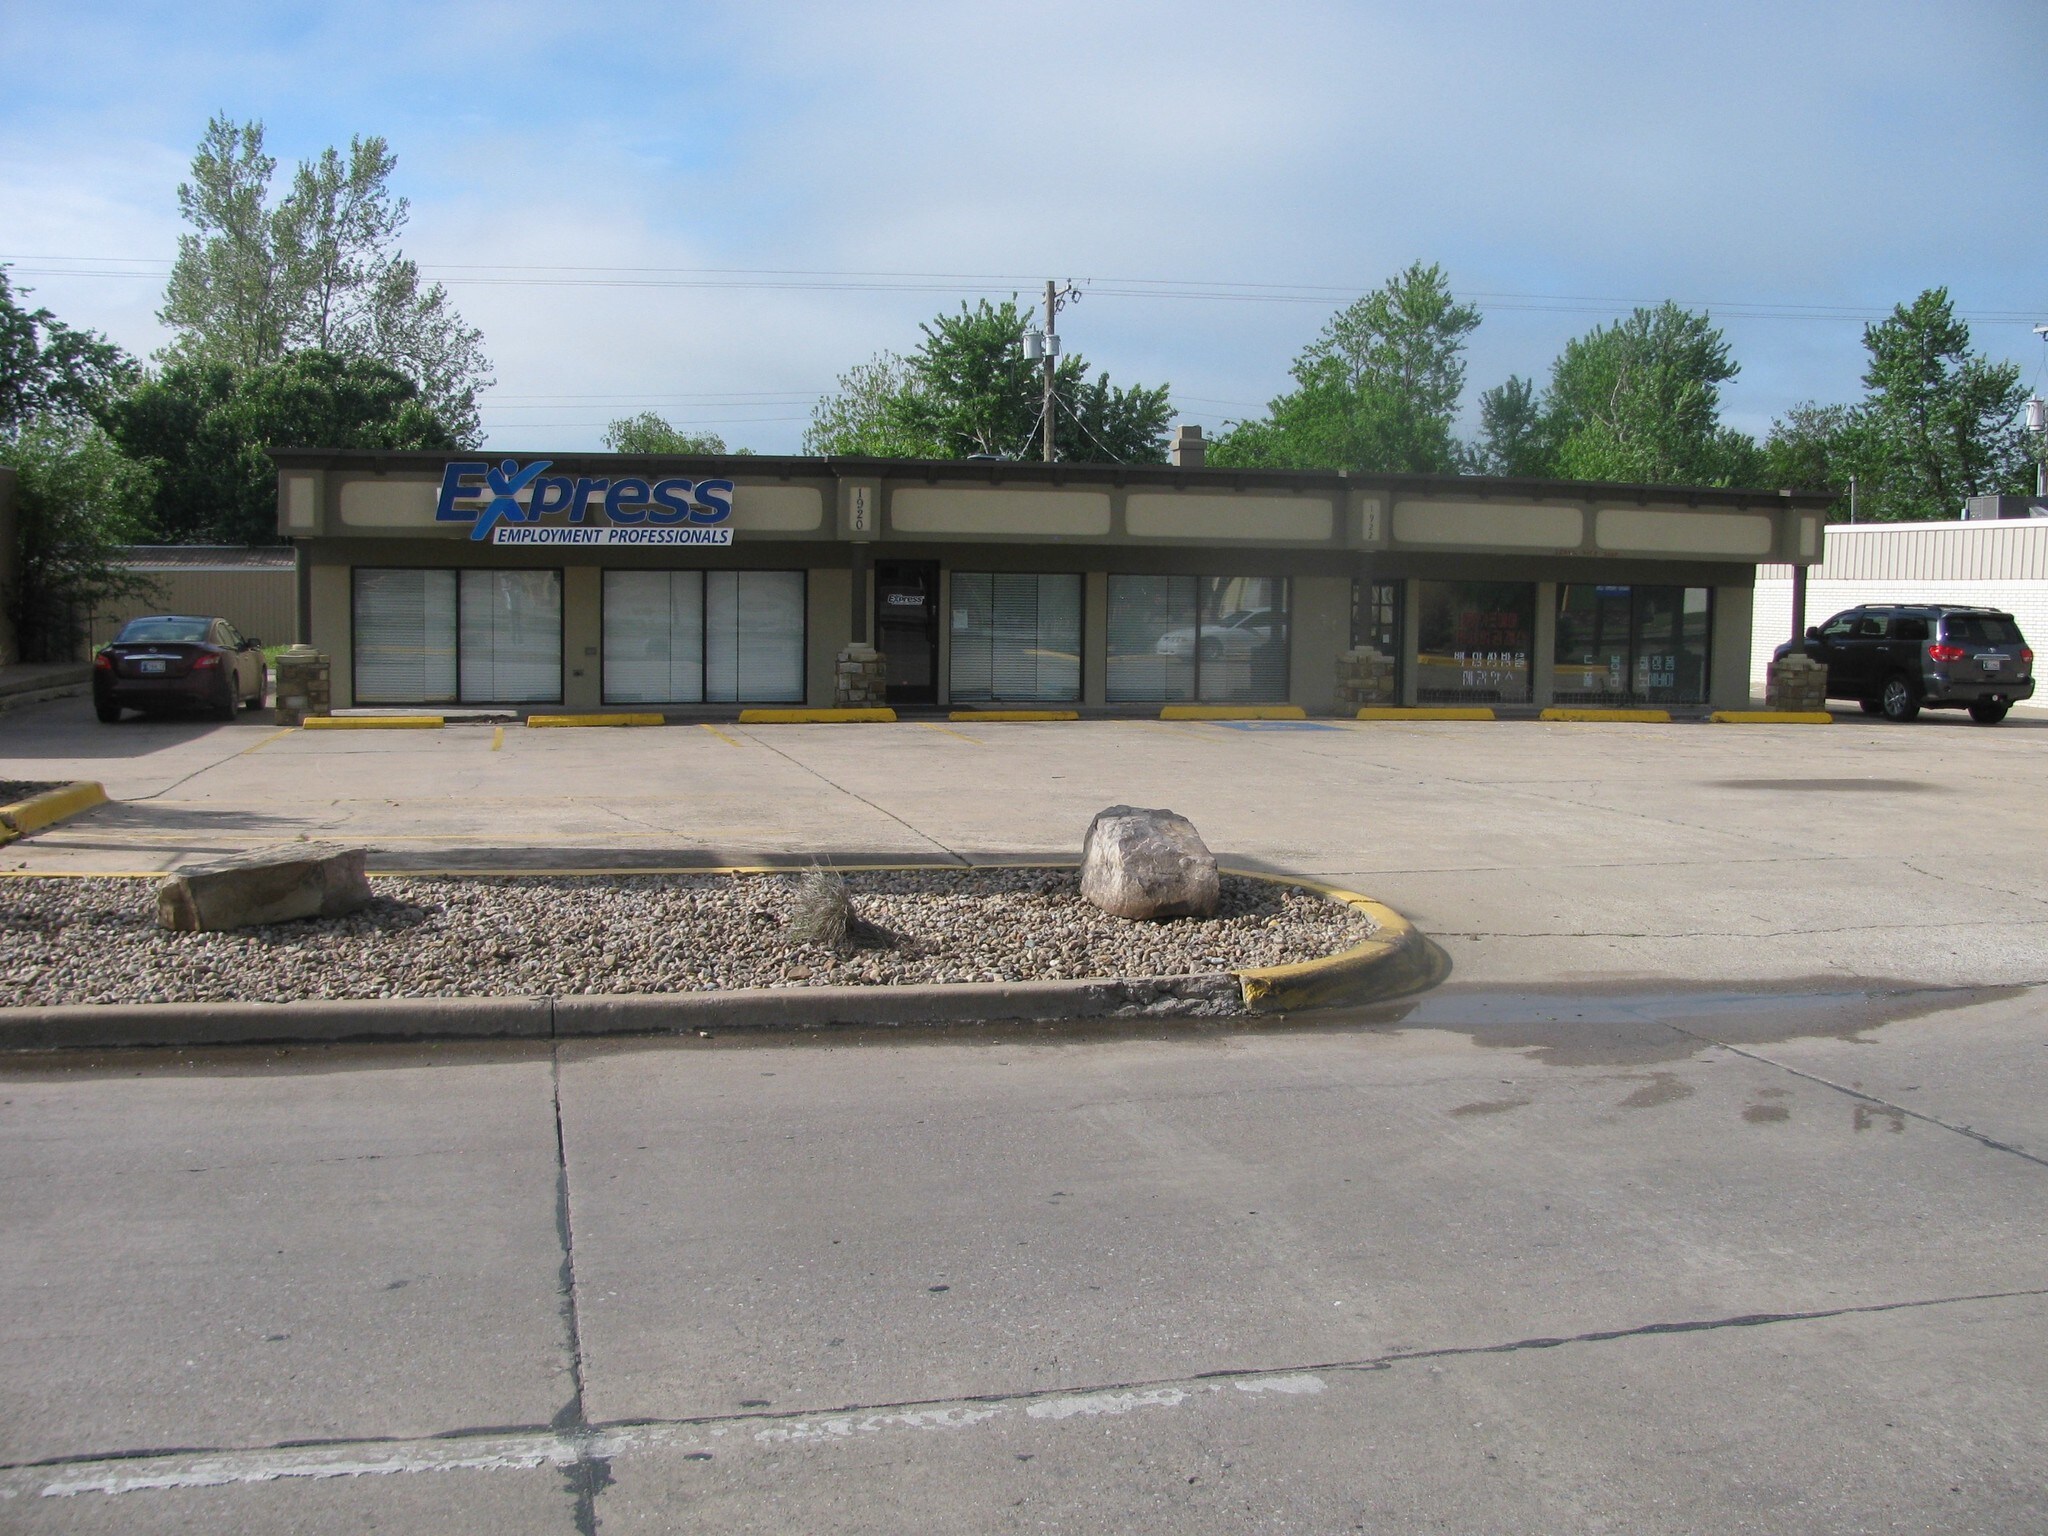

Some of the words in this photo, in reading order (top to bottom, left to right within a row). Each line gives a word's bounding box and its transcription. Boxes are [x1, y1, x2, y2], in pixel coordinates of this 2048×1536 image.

[434, 459, 735, 541] Express
[855, 488, 864, 530] 1920
[497, 528, 603, 543] EMPLOYMENT
[607, 528, 729, 544] PROFESSIONALS
